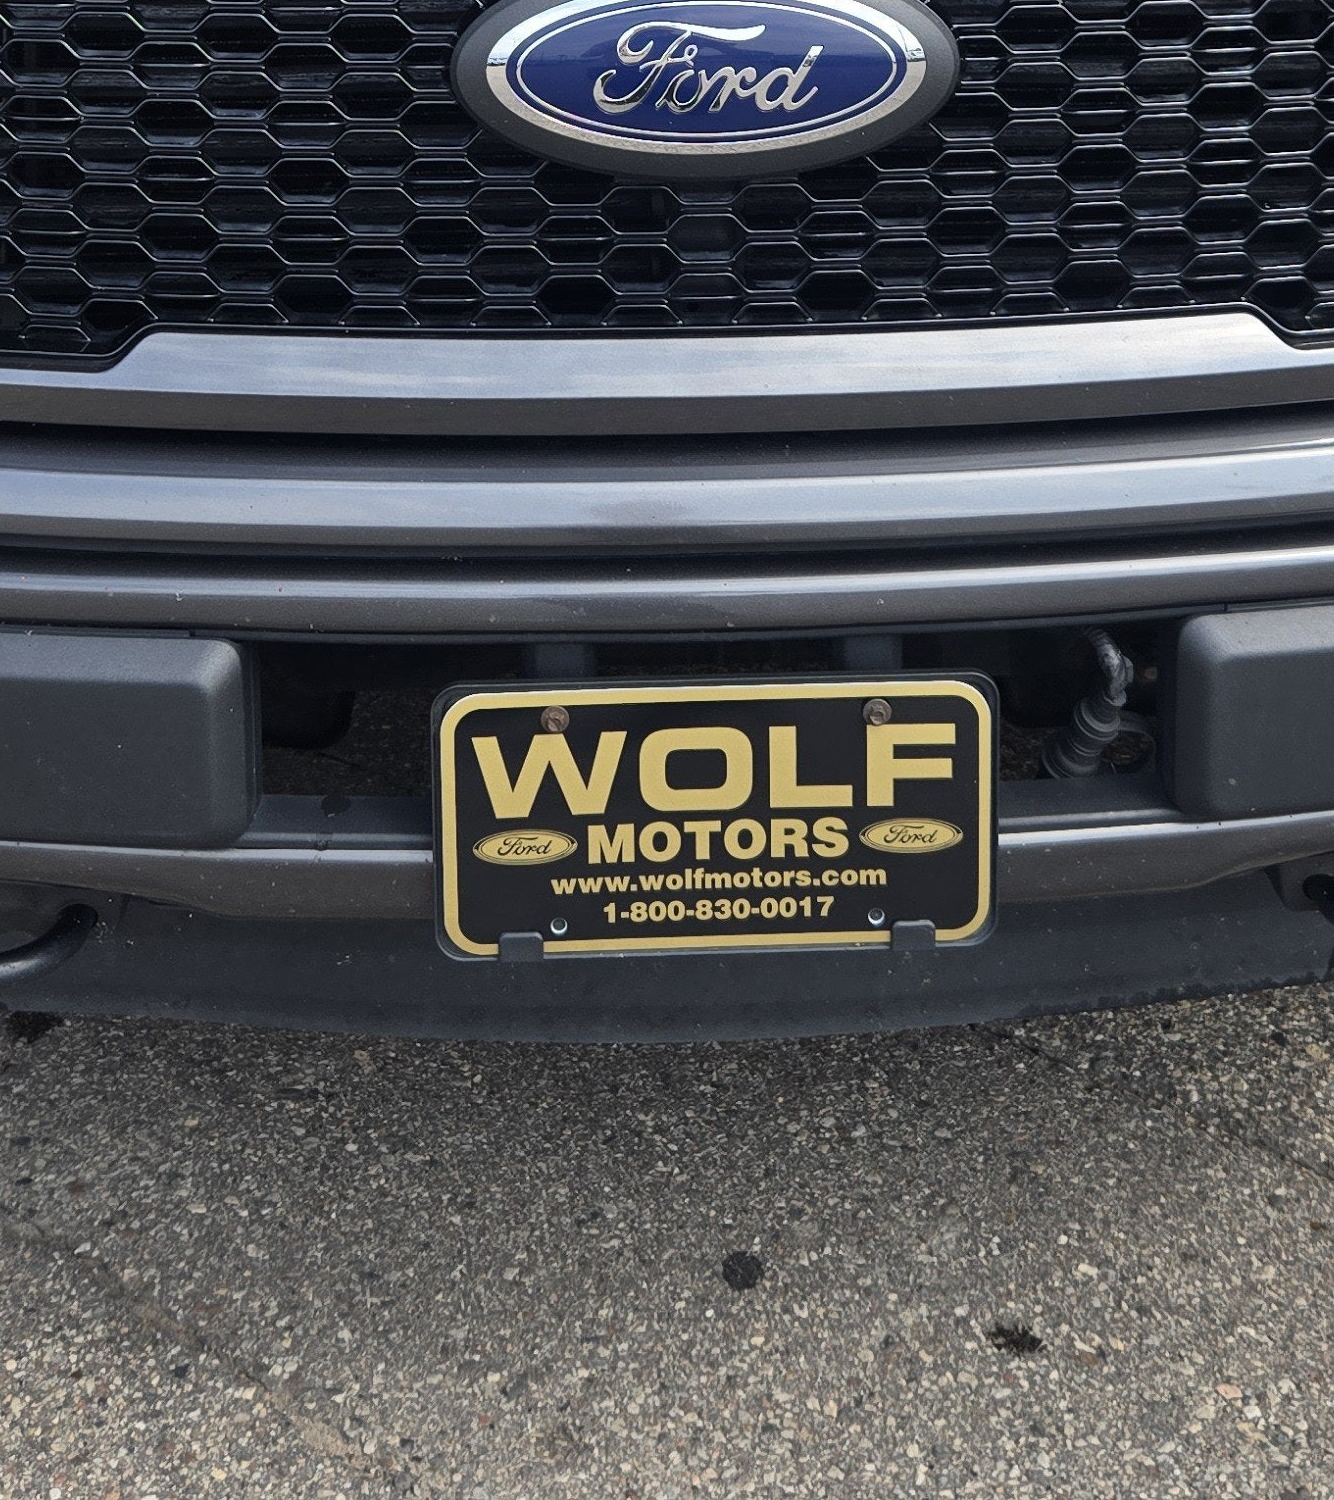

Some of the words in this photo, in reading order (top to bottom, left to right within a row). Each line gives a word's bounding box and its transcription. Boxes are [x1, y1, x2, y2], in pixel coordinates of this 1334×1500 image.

[592, 20, 825, 114] Ford
[471, 722, 956, 820] WOLF
[497, 836, 553, 857] Ford
[587, 817, 850, 865] MOTORS
[883, 824, 938, 844] Ford
[551, 866, 887, 897] www.wolfmotors.com
[603, 896, 835, 924] 1-800-830-0017
